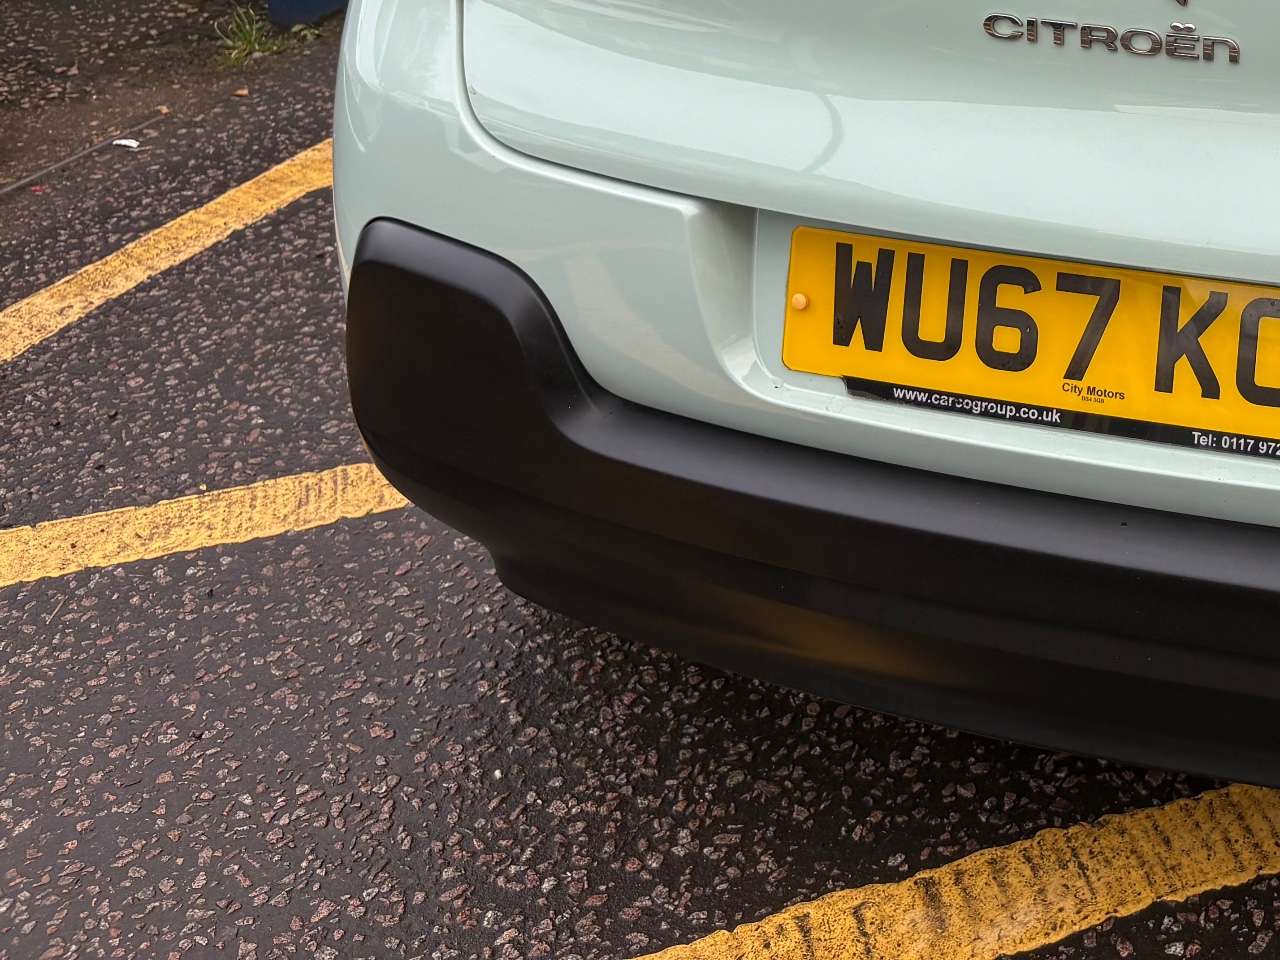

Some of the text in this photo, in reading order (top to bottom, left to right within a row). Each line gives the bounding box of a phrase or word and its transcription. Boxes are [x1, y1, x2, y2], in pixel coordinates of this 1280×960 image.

[833, 241, 1121, 382] WU67
[1061, 382, 1126, 400] City Motors
[1191, 431, 1217, 447] Tel:
[1221, 435, 1255, 452] 0117
